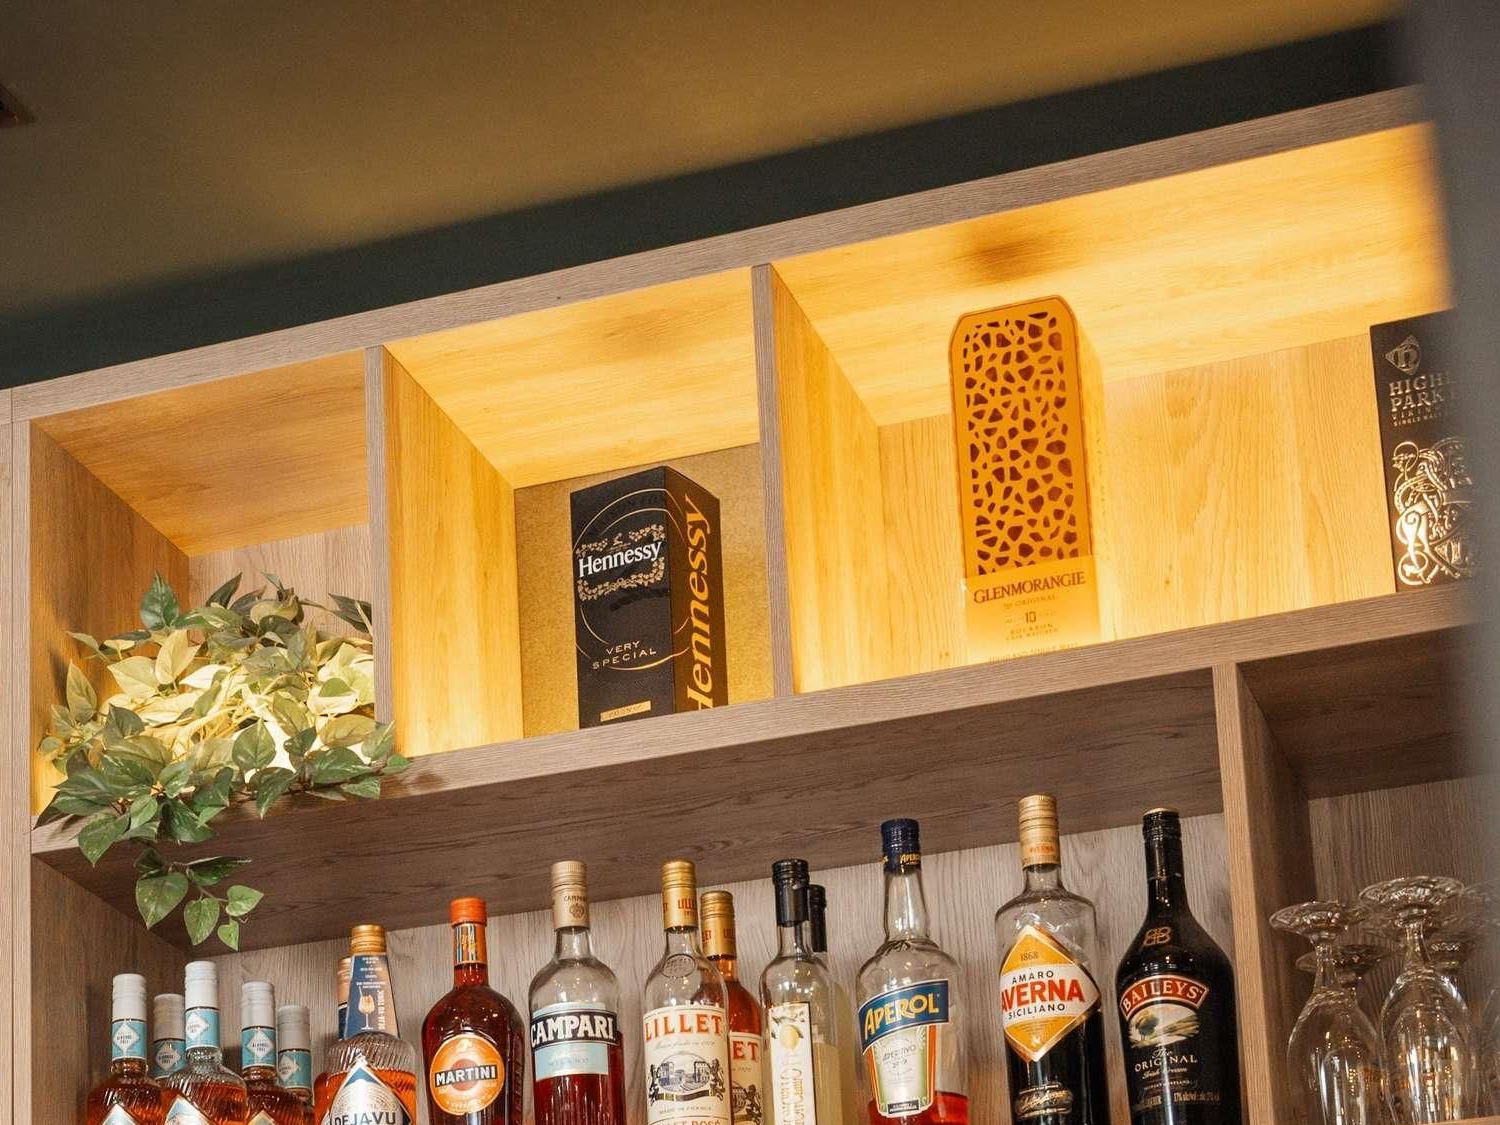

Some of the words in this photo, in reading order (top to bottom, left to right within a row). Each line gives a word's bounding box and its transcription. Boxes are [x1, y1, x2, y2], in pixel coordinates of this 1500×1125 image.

[577, 541, 663, 578] Hennessy
[972, 571, 1086, 604] GLENMORANGIE
[1023, 610, 1037, 626] 10
[591, 649, 658, 670] SPECIAL
[605, 640, 641, 657] VERY
[1019, 949, 1039, 962] 1868
[1011, 969, 1055, 987] AMARO
[1122, 979, 1202, 1014] BAILEYS
[863, 992, 940, 1041] APEROL
[1008, 1002, 1066, 1020] SICILIANO
[531, 1013, 614, 1049] CAMPARI
[645, 1013, 723, 1042] LILLET
[434, 1065, 497, 1087] MARTINI
